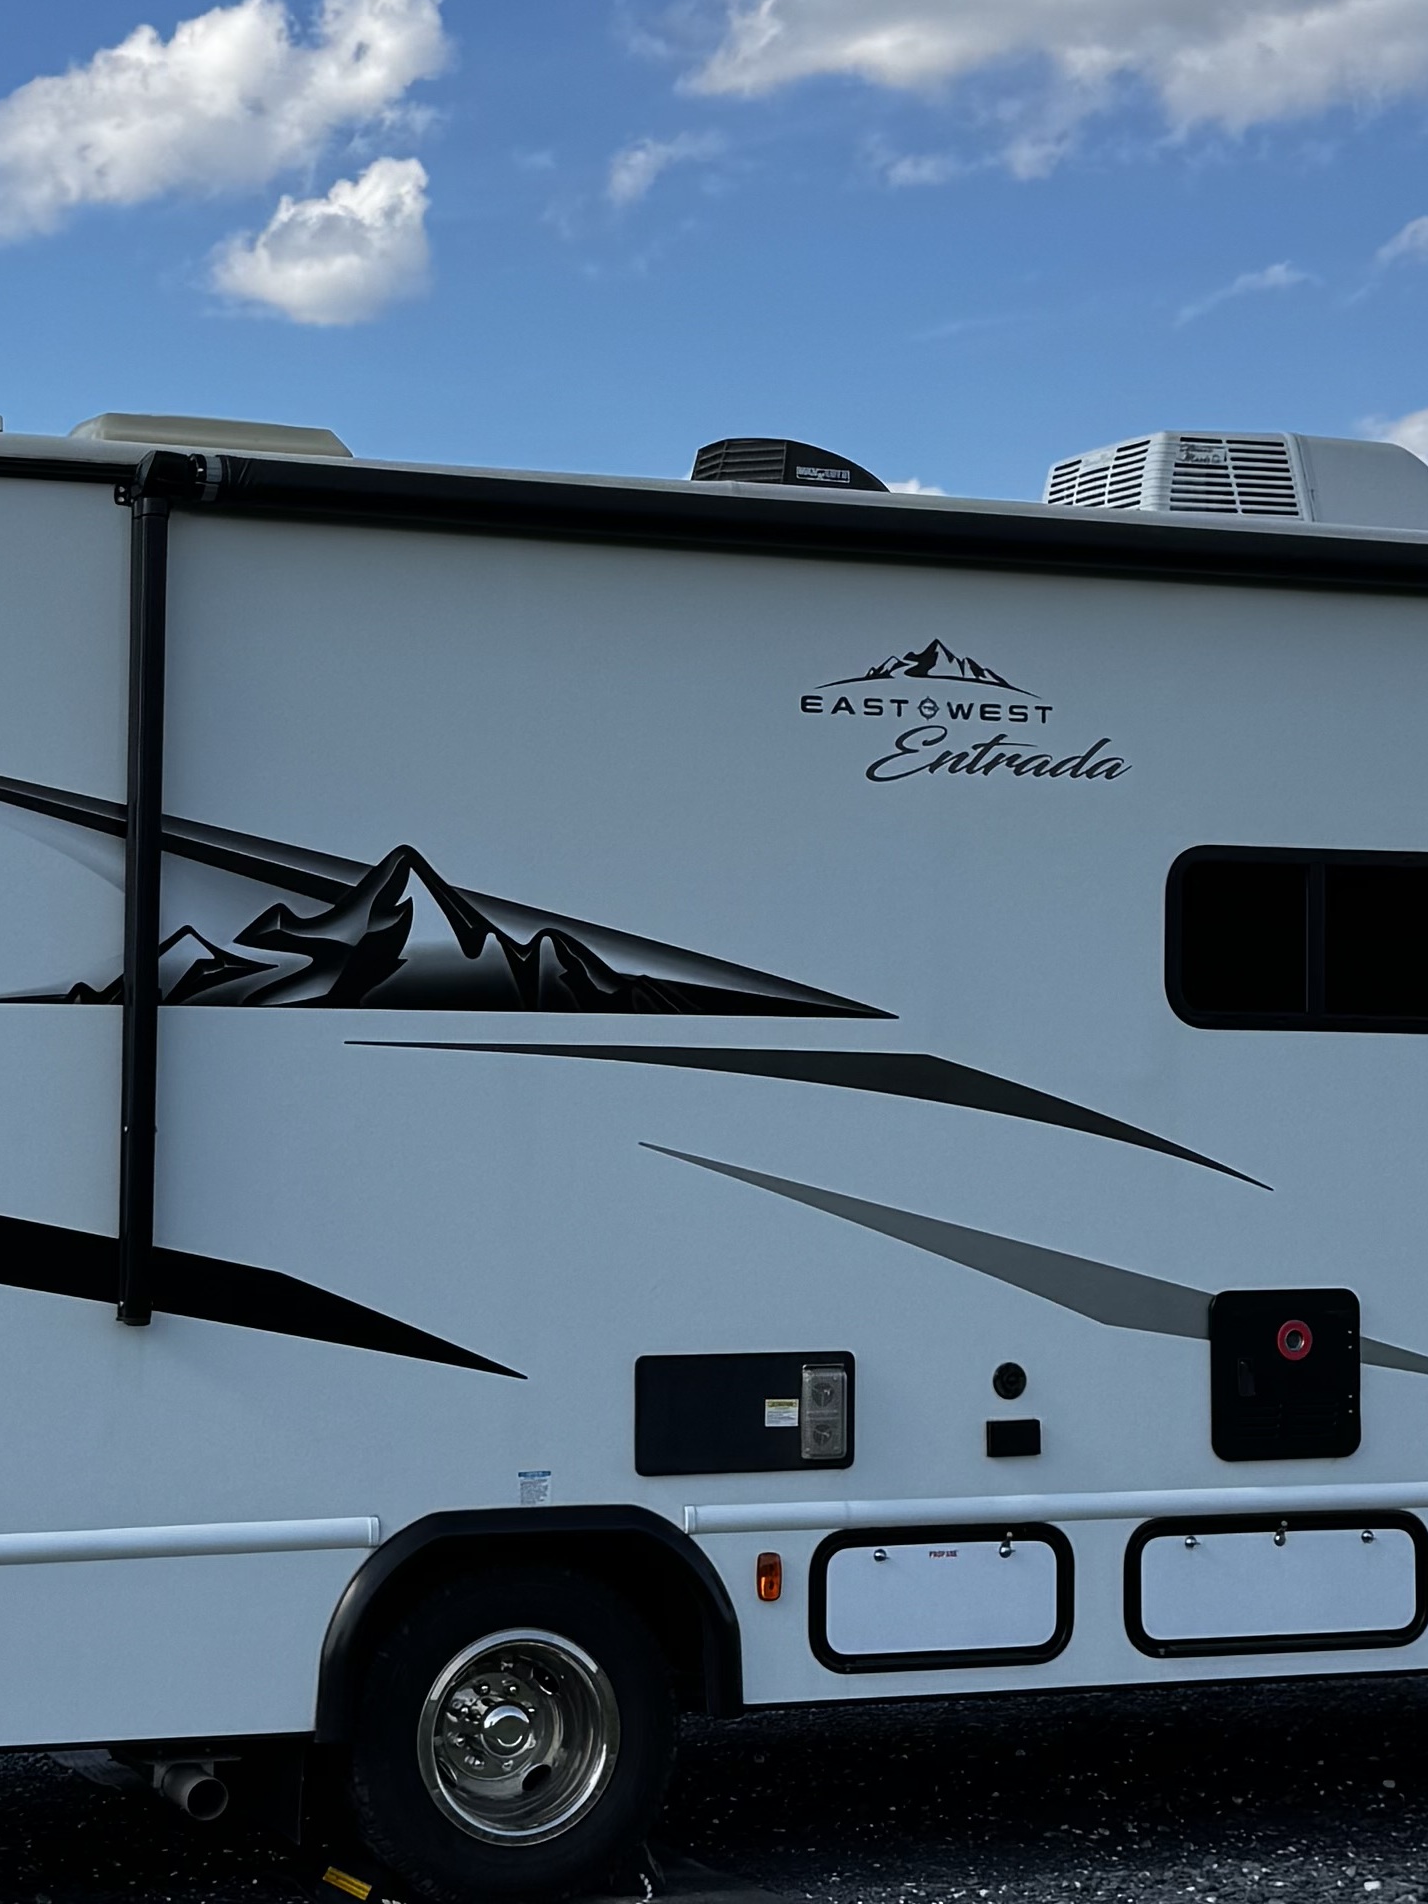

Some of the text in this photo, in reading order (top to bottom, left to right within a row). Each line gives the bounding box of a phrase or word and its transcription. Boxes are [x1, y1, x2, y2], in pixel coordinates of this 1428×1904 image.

[800, 695, 1053, 724] EAST WEST
[865, 724, 1133, 782] Entrada
